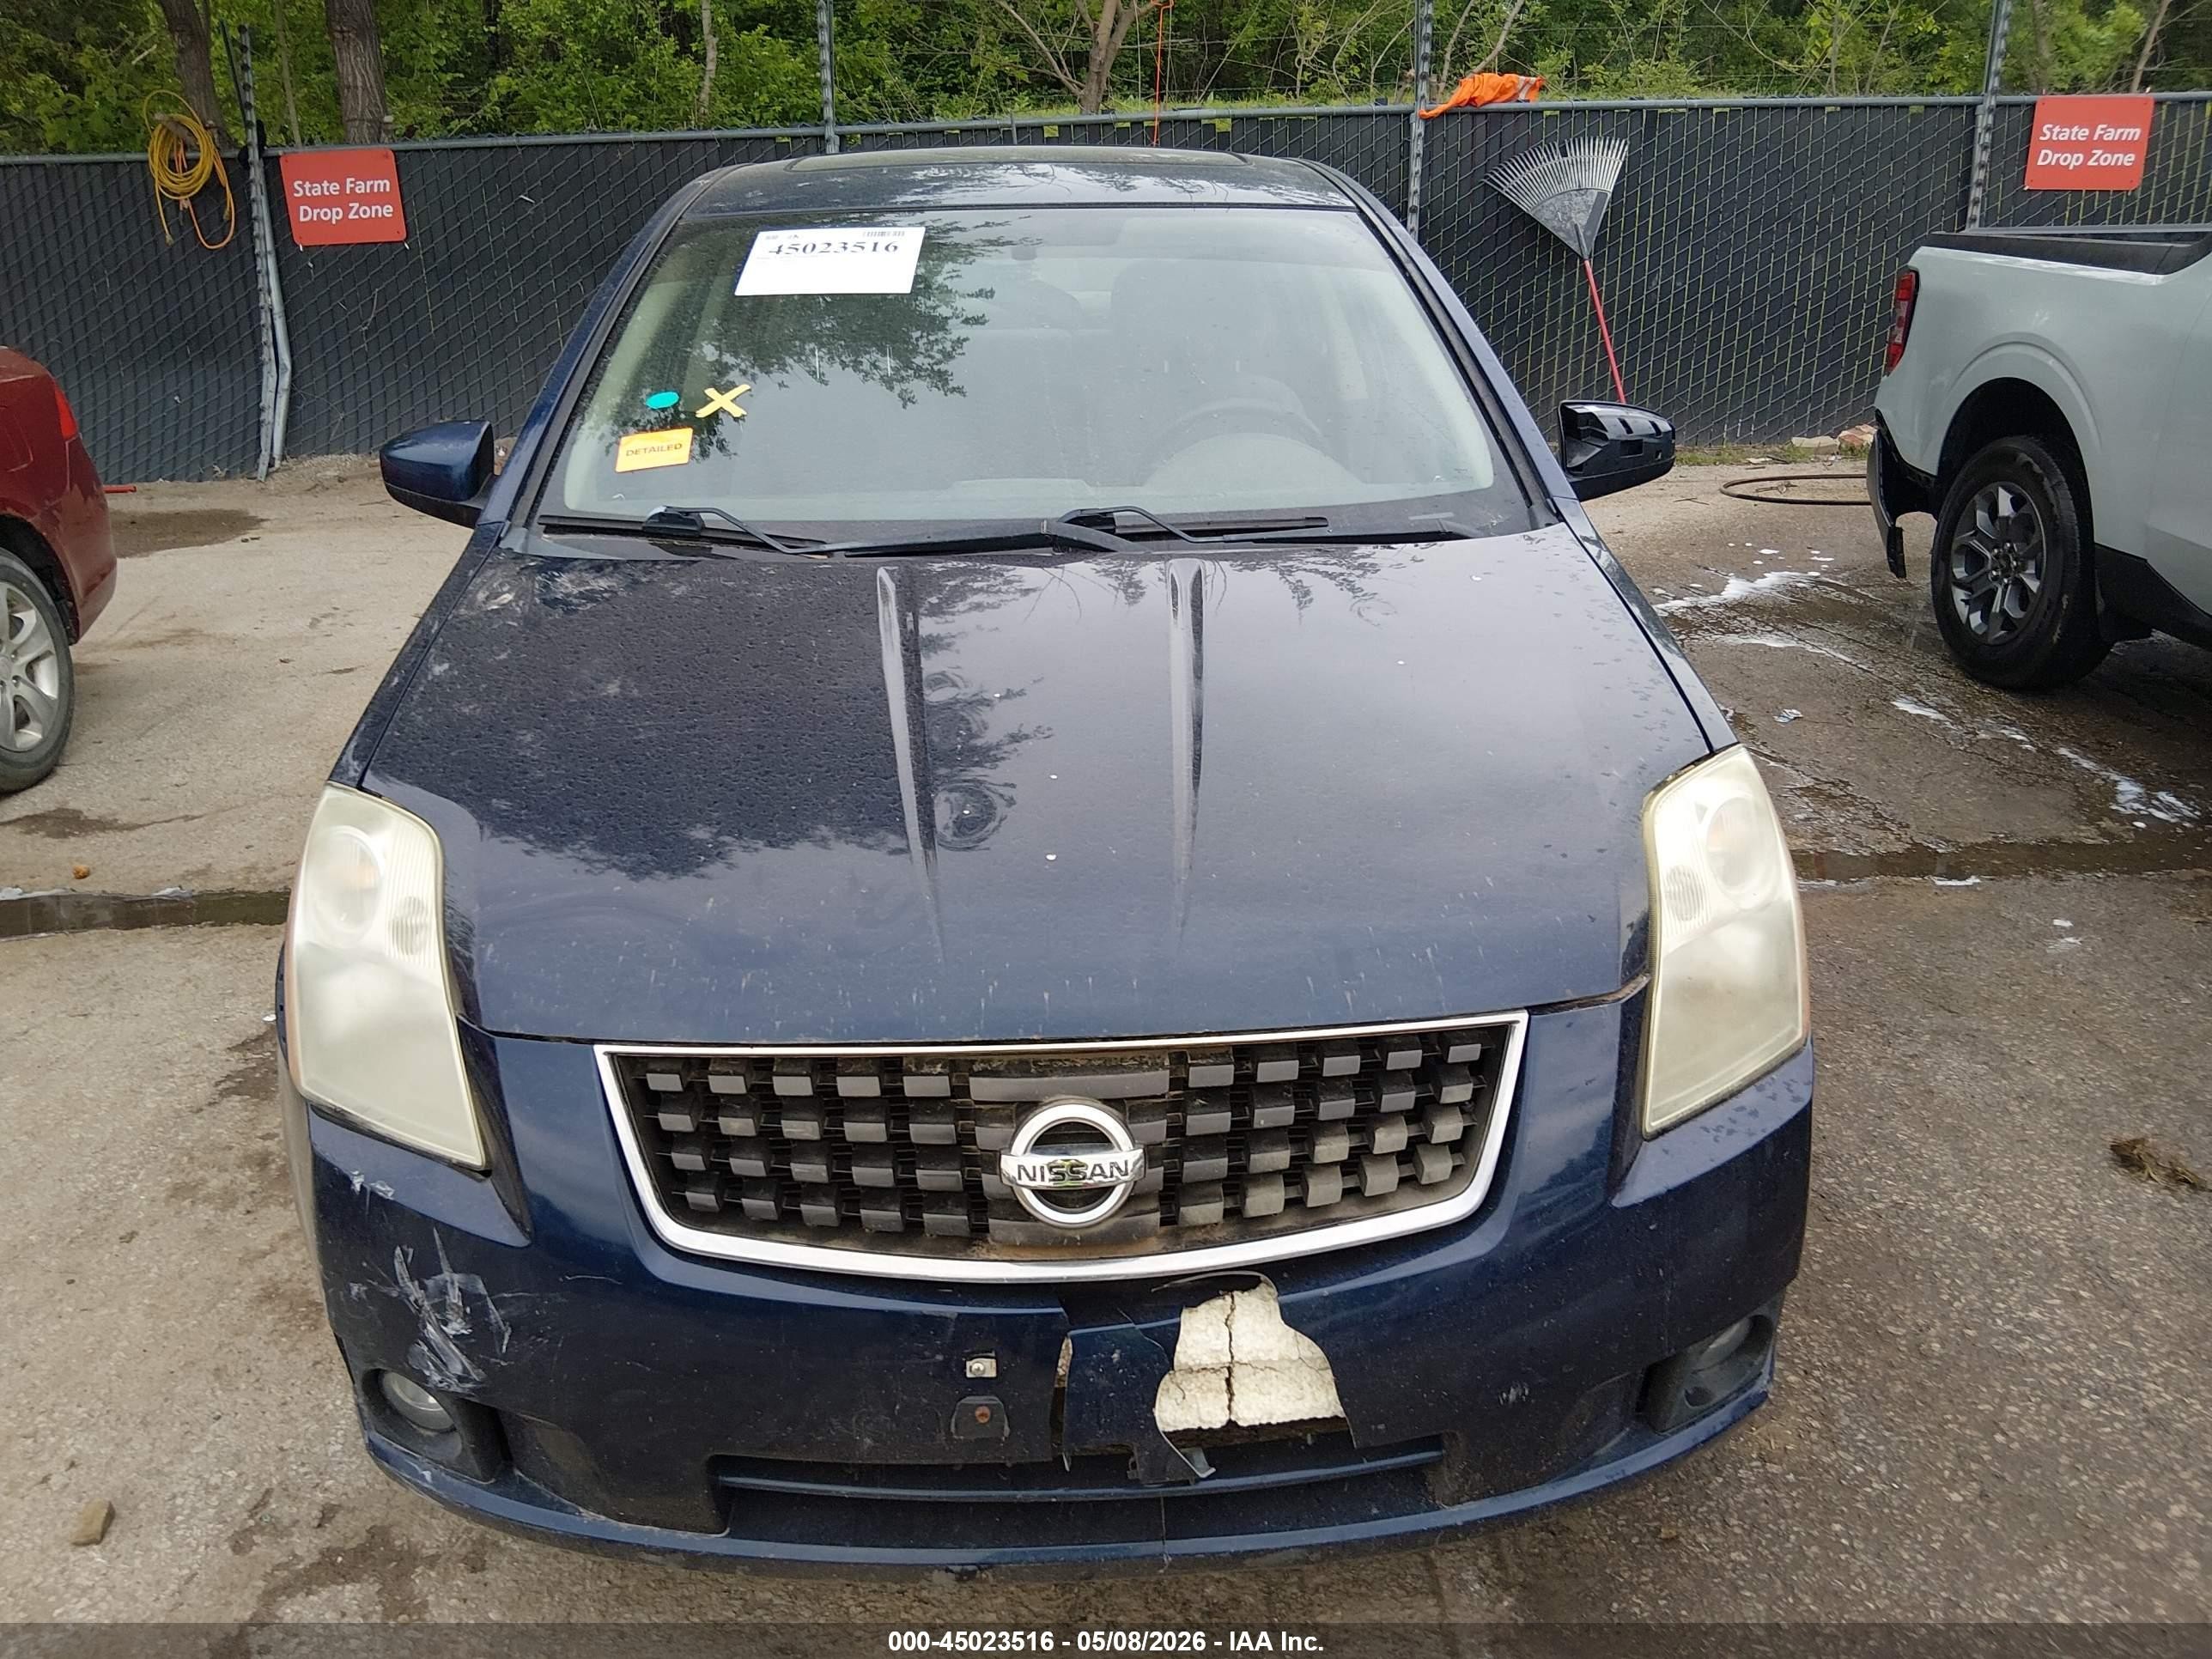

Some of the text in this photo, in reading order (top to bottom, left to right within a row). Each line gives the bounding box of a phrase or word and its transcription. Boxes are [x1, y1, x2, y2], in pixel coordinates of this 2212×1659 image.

[2039, 124, 2142, 142] State Farm
[2037, 149, 2136, 170] Drop Zone
[293, 177, 391, 198] State Farm
[299, 202, 393, 224] Drop Zone
[768, 240, 899, 256] 45023516
[625, 442, 683, 457] DETAILED
[1017, 1159, 1130, 1182] NISSAN
